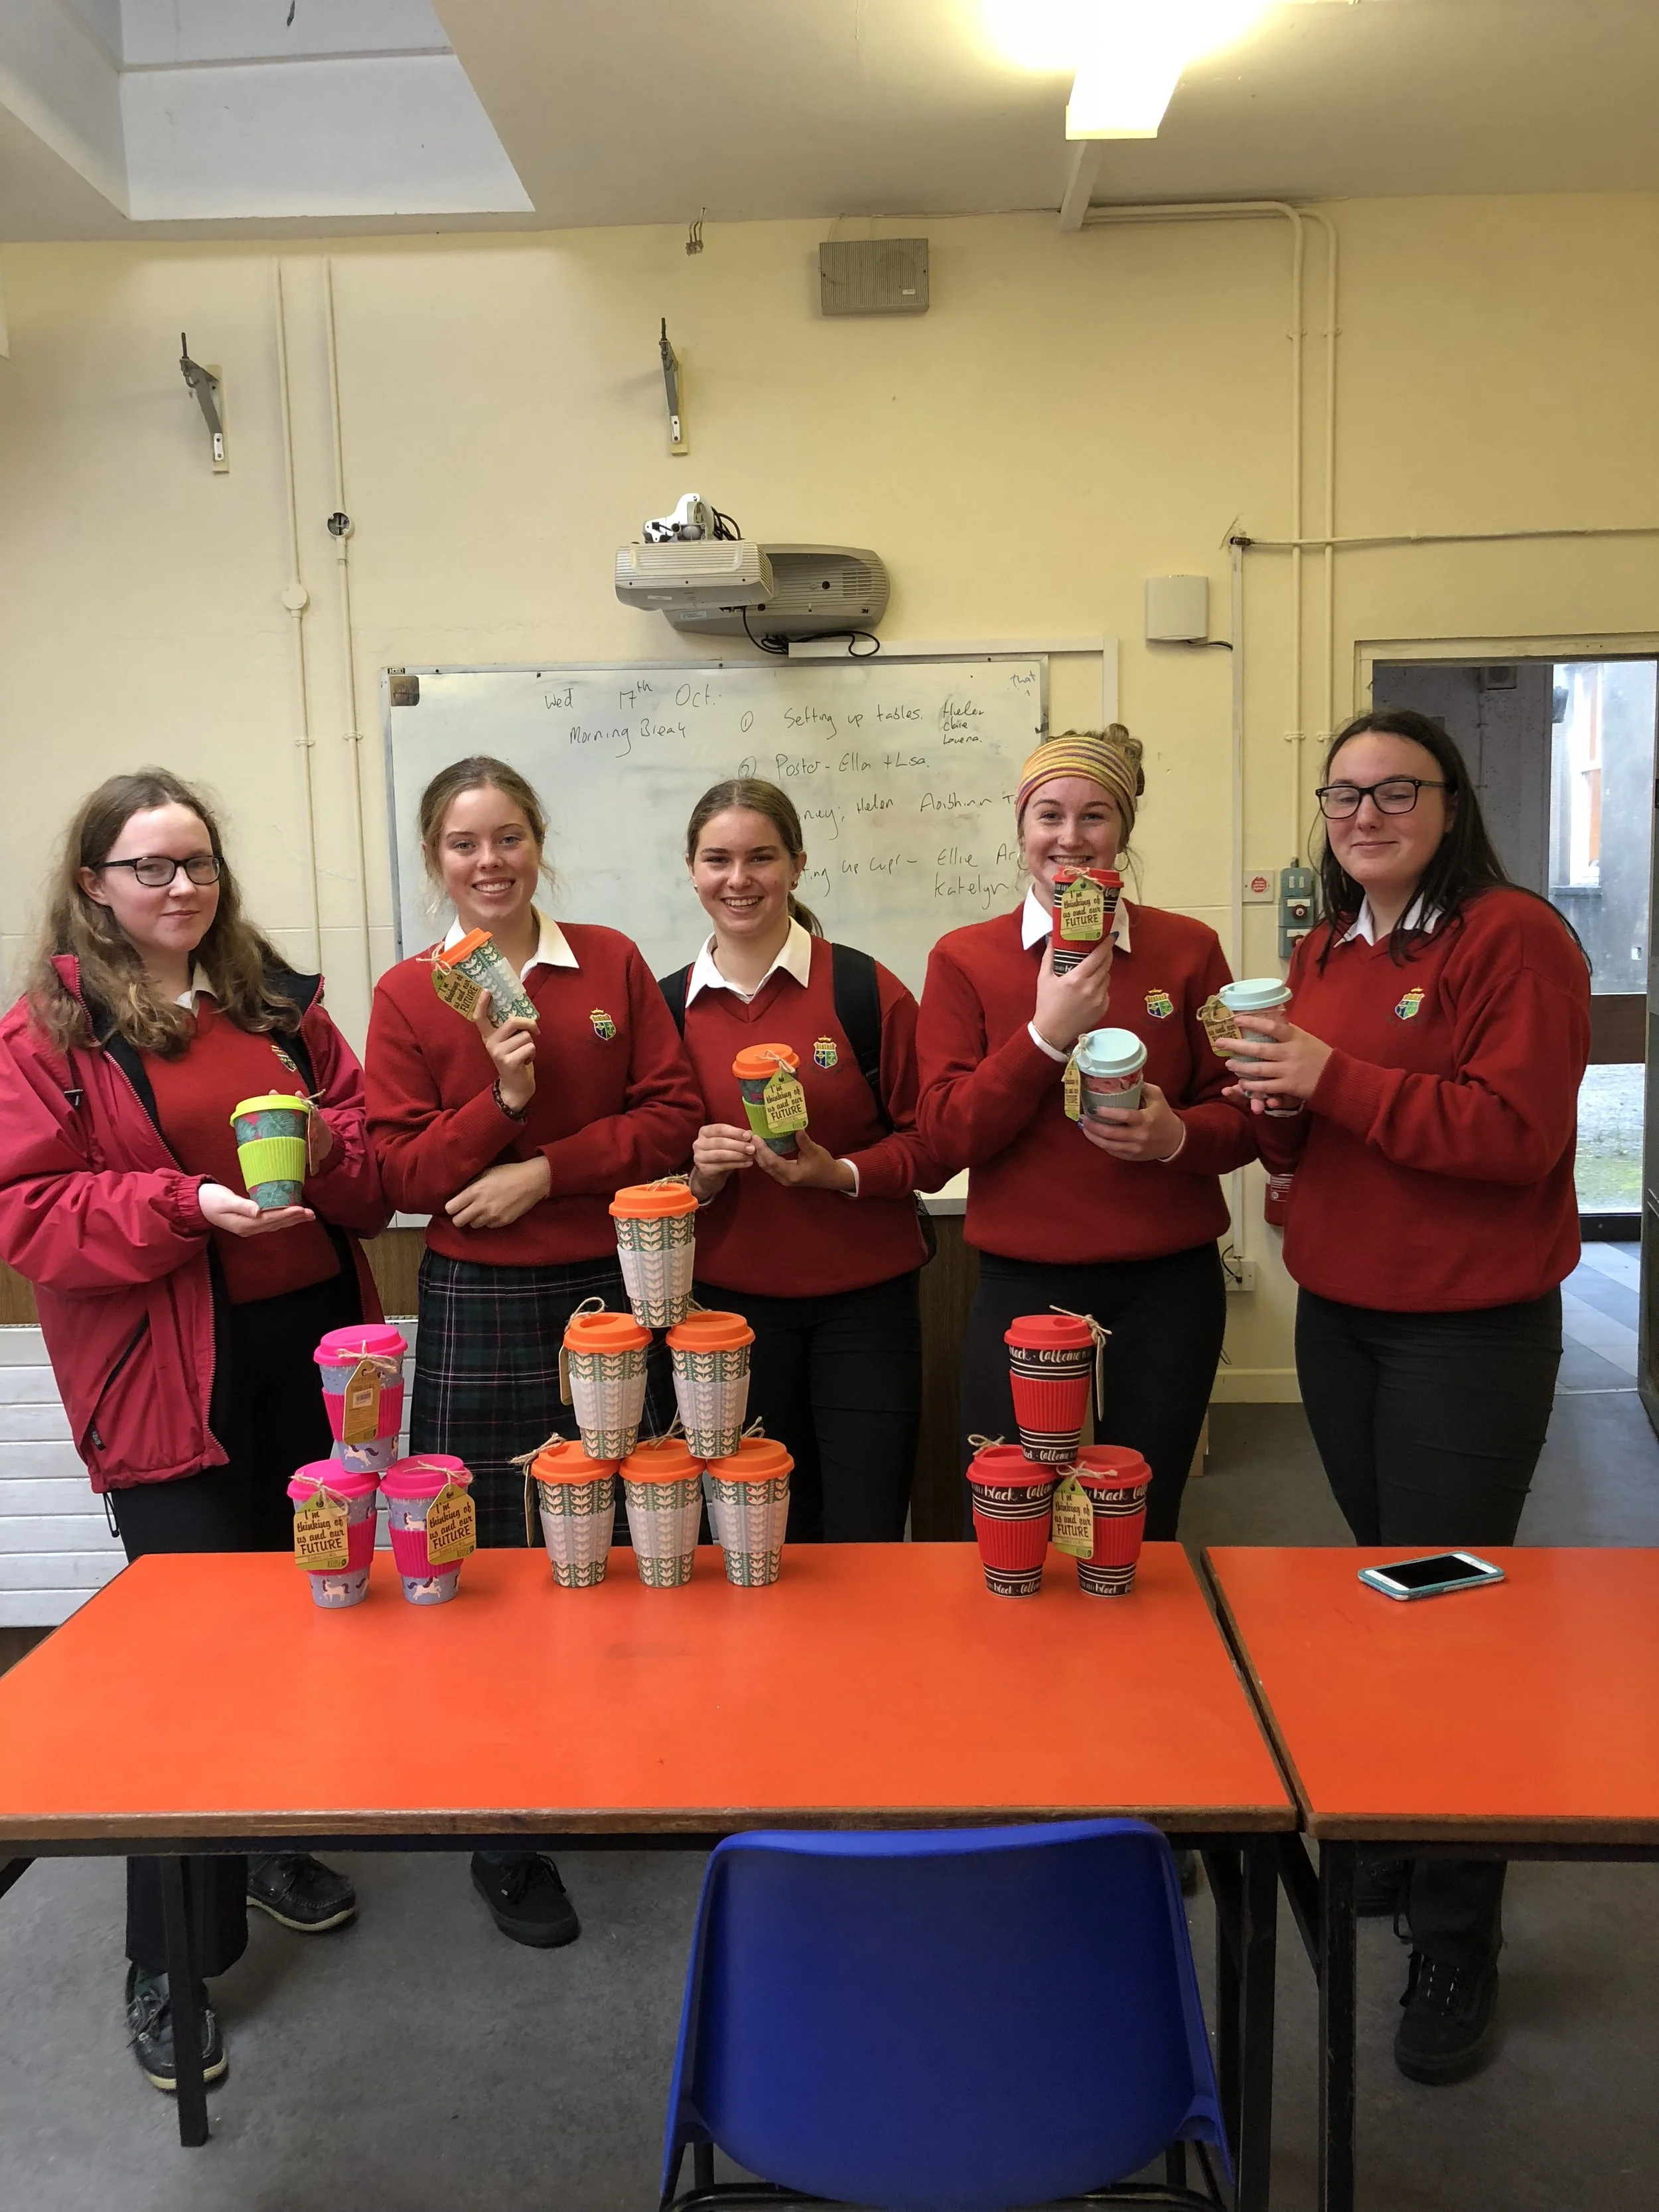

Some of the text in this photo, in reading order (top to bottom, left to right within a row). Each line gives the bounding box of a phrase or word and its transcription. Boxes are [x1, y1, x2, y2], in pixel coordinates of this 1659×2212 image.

[544, 688, 574, 709] Wed
[620, 680, 653, 709] 17th
[784, 705, 837, 741] Setting
[847, 714, 863, 728] up
[876, 703, 923, 722] tables.
[569, 718, 686, 759] Morning Break
[838, 751, 871, 773] Ella
[857, 793, 894, 814] Helen
[937, 846, 979, 867] Ellie
[1064, 899, 1091, 909] thinking
[1072, 907, 1086, 917] and
[1065, 914, 1099, 927] FUTURE
[459, 985, 478, 1012] FUTURE
[766, 1086, 800, 1104] thinking of
[770, 1084, 783, 1093] I'm
[770, 1104, 802, 1121] FUTURE
[776, 1100, 789, 1110] and
[984, 1484, 1018, 1501] black
[1093, 1487, 1128, 1501] black
[304, 1509, 320, 1520] I'm
[429, 1501, 472, 1528] thinking of
[435, 1502, 451, 1514] I'm
[1055, 1501, 1090, 1516] thinking of
[297, 1516, 343, 1533] thinking of
[429, 1515, 473, 1540] us and our
[1064, 1514, 1076, 1524] and
[1079, 1518, 1091, 1526] our
[309, 1529, 326, 1542] and
[329, 1529, 344, 1538] our
[432, 1524, 471, 1550] FUTURE
[1056, 1524, 1090, 1538] FUTURE
[300, 1538, 343, 1555] FUTURE
